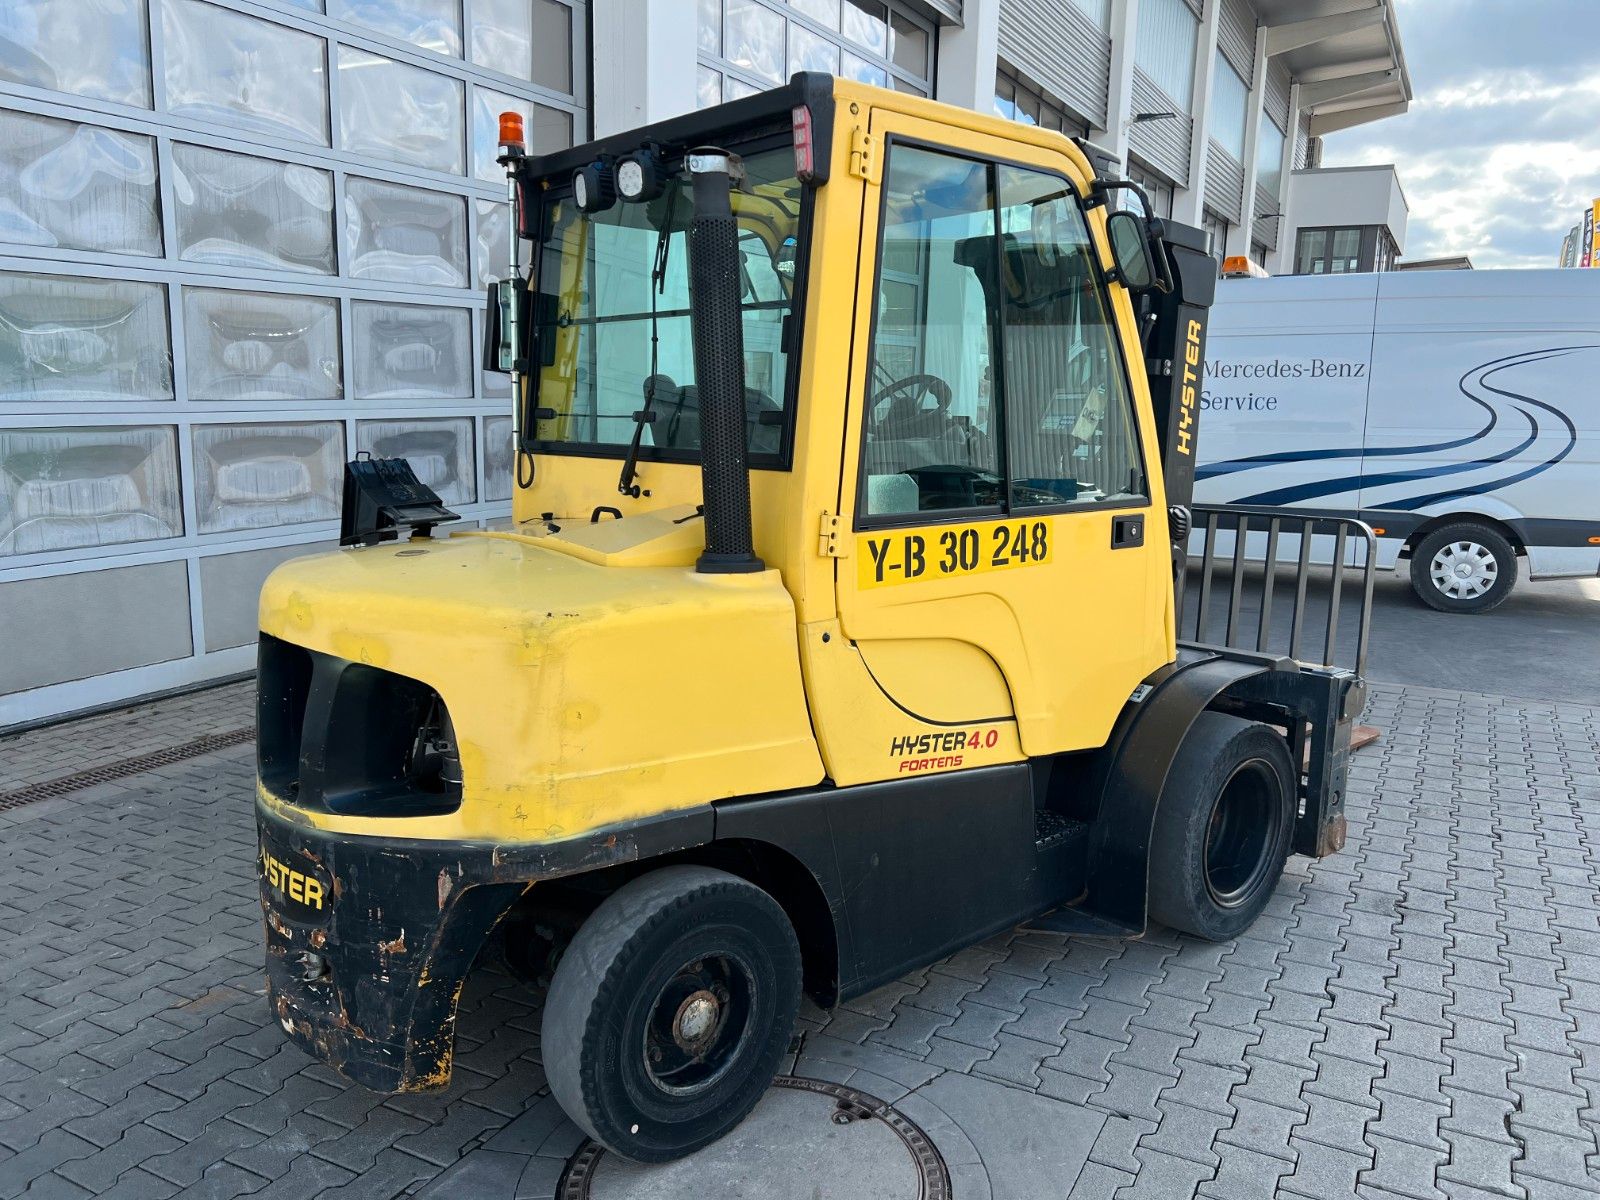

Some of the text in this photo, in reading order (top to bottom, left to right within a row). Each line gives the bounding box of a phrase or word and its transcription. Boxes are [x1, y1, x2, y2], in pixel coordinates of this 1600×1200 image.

[1203, 359, 1365, 378] Mercedes-Benz
[1177, 319, 1201, 455] HYSTER
[1200, 391, 1278, 411] Service
[868, 522, 1048, 582] Y-B 30 248
[890, 729, 999, 757] HYSTER 4.0
[899, 755, 963, 772] FORTENS
[258, 846, 323, 910] YSTER
